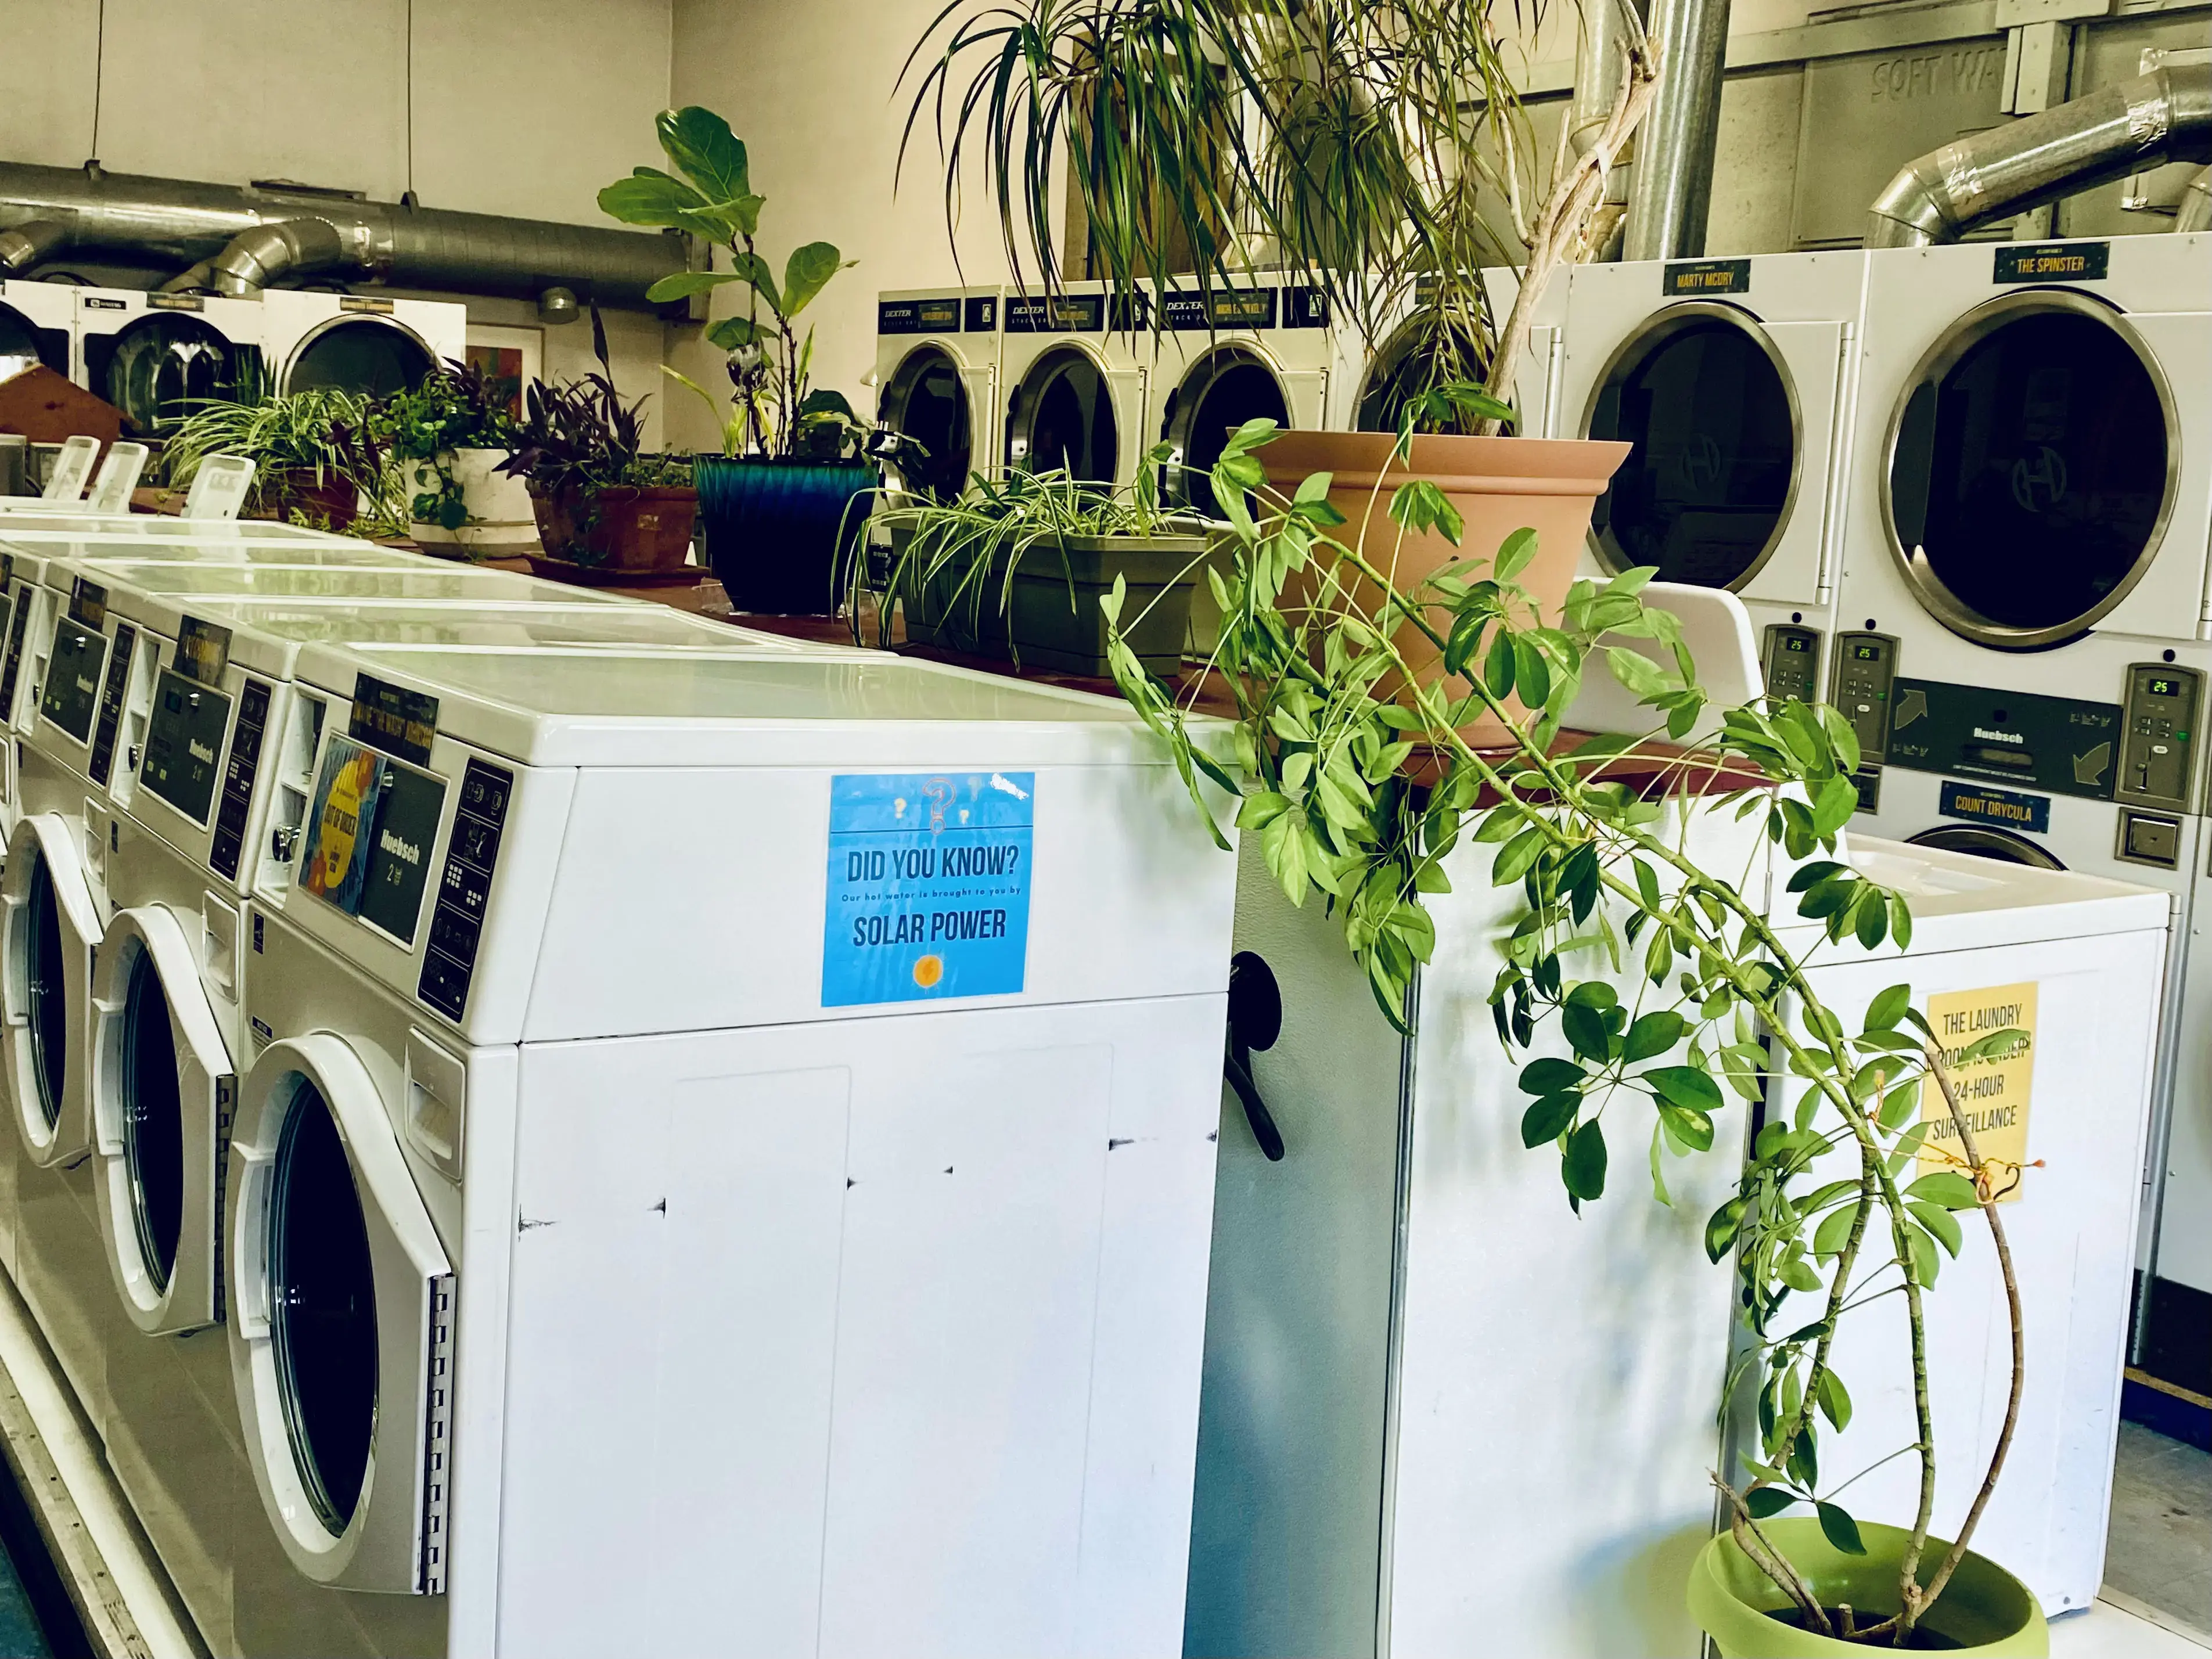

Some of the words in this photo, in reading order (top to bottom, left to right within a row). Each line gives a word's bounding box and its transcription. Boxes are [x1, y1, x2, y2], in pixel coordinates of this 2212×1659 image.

[1871, 55, 1943, 102] SOFT
[2017, 258, 2035, 273] THE
[2037, 256, 2085, 272] SPINSTER
[1677, 273, 1704, 288] MARTY
[1704, 271, 1734, 286] MCDRY
[1791, 640, 1802, 650] 25
[1859, 648, 1871, 658] 25
[2154, 681, 2167, 693] 25
[1974, 727, 2024, 744] Huebsch
[1955, 796, 1987, 814] COUNT
[1987, 800, 2032, 822] DRYCULA
[381, 829, 420, 865] Huebsch
[848, 850, 886, 882] DID
[891, 848, 936, 880] YOU
[941, 845, 1019, 877] KNOW?
[865, 893, 881, 901] hot
[885, 891, 915, 900] water
[932, 888, 972, 898] brought
[989, 888, 1006, 897] you
[1009, 886, 1021, 895] by
[853, 913, 925, 947] SOLAR
[930, 909, 1006, 942] POWER
[1944, 1012, 1966, 1035] THE
[1969, 1003, 2023, 1032] LAUNDRY
[1954, 1074, 2004, 1102] 24-HOUR
[1933, 1104, 2017, 1141] SUREILLANCE
